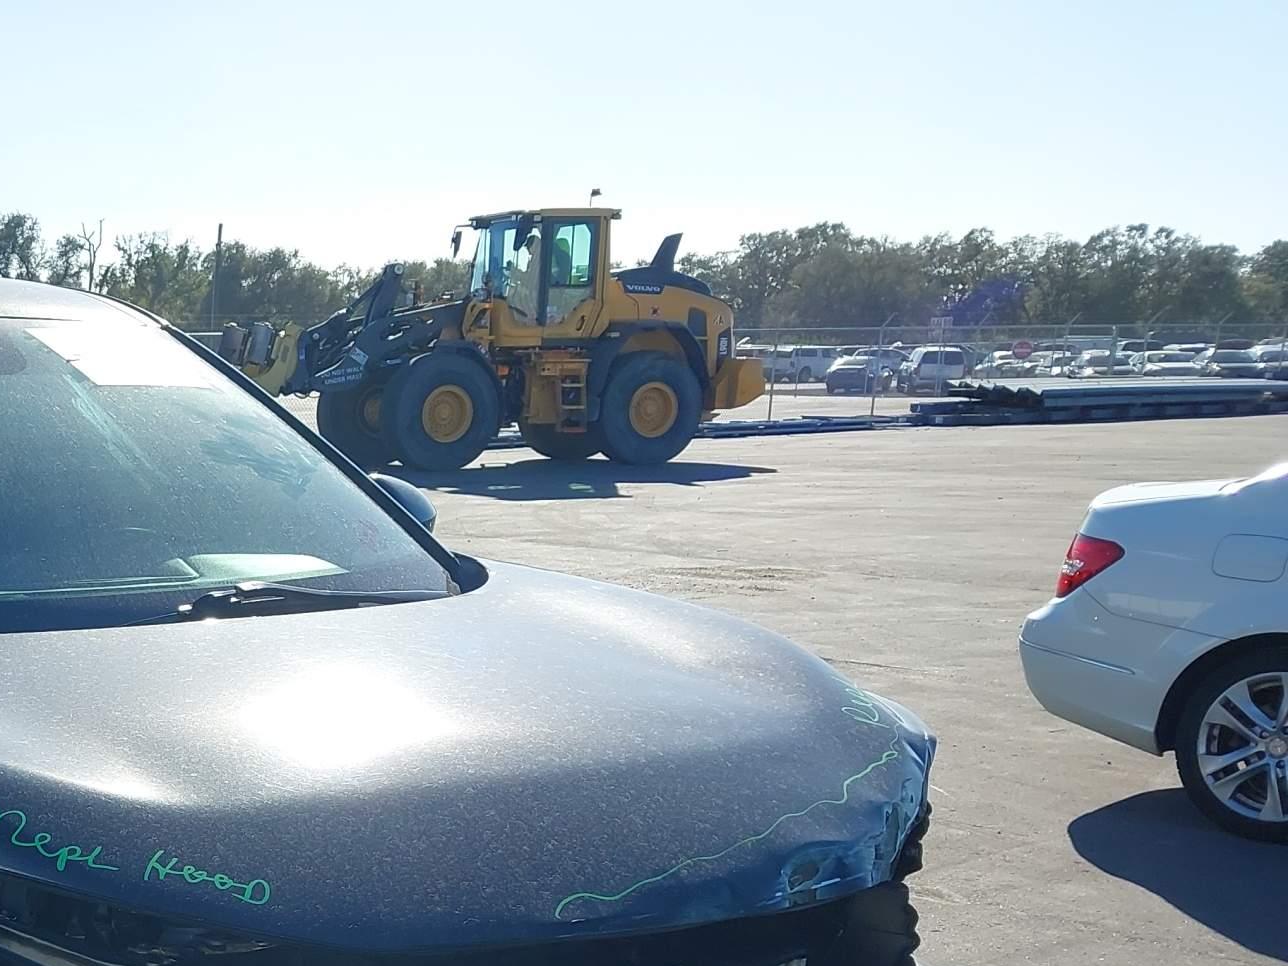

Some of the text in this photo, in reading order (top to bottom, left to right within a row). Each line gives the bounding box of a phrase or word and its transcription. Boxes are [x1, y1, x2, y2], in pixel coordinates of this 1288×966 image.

[626, 284, 661, 292] VOLVO
[331, 368, 345, 376] NOT
[324, 373, 362, 385] UNDER MAST
